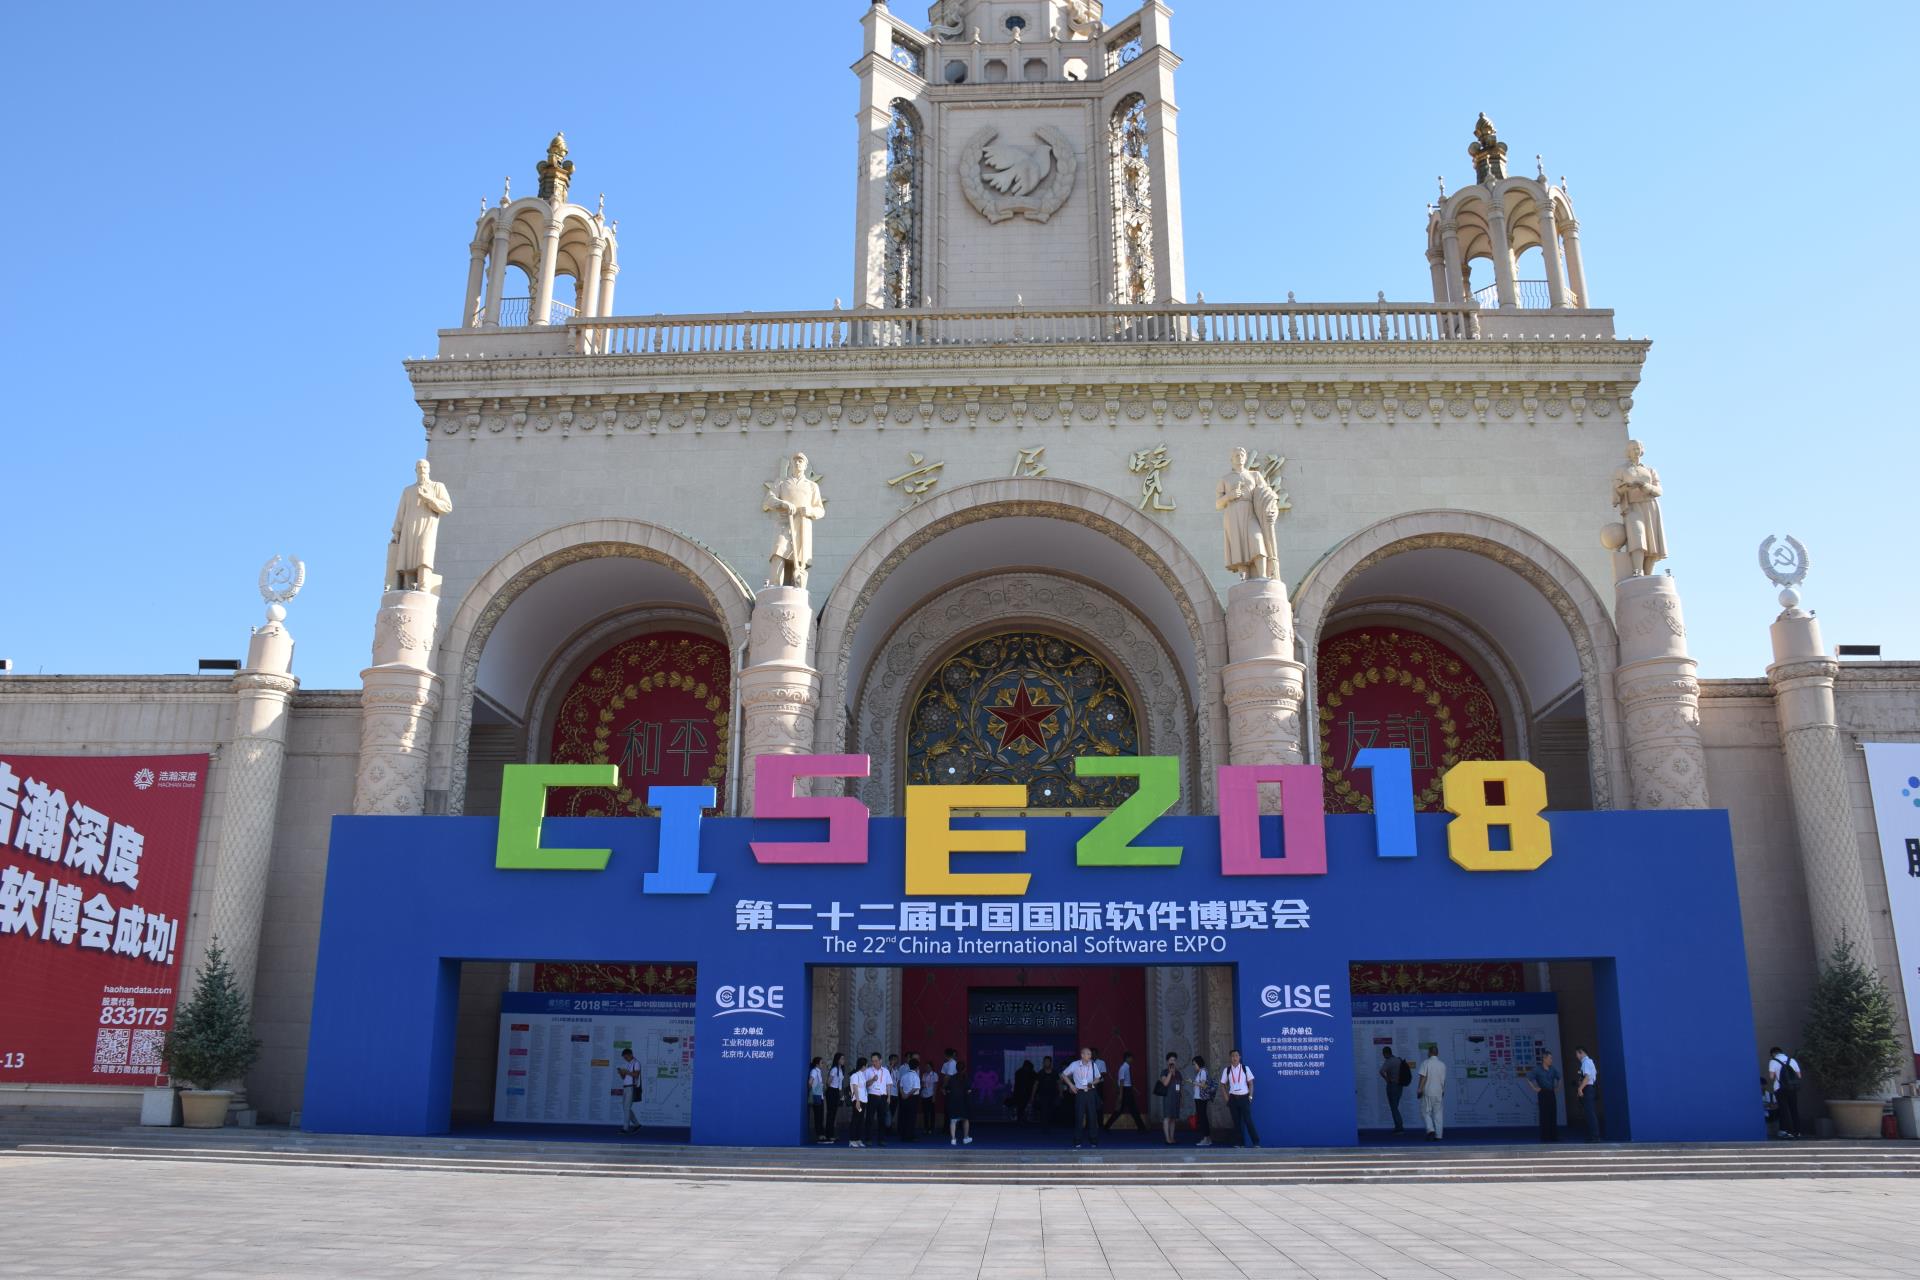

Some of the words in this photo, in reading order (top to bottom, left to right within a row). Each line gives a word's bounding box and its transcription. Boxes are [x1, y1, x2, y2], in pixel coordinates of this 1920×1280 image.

[617, 719, 709, 776] 和平
[158, 771, 197, 782] 浩瀚深度
[736, 899, 1310, 932] 第二十二届中国国际软件博览会
[823, 936, 857, 953] The
[863, 936, 896, 953] 22nd
[899, 936, 951, 954] China
[957, 936, 1077, 954] International
[1084, 936, 1167, 954] Software
[1174, 936, 1226, 953] EXPO
[103, 985, 172, 995] haohandata.com
[715, 985, 784, 1008] CISE
[1261, 985, 1331, 1008] CISE
[101, 998, 134, 1007] 股票代码
[573, 1000, 600, 1011] 2018
[1372, 1001, 1400, 1013] 2018
[99, 1006, 168, 1026] 833175
[733, 1027, 763, 1035] 主办单位
[1281, 1027, 1312, 1035] 承办单位
[722, 1038, 775, 1047] 工业和信息化部
[721, 1050, 774, 1059] 北京市人民政府
